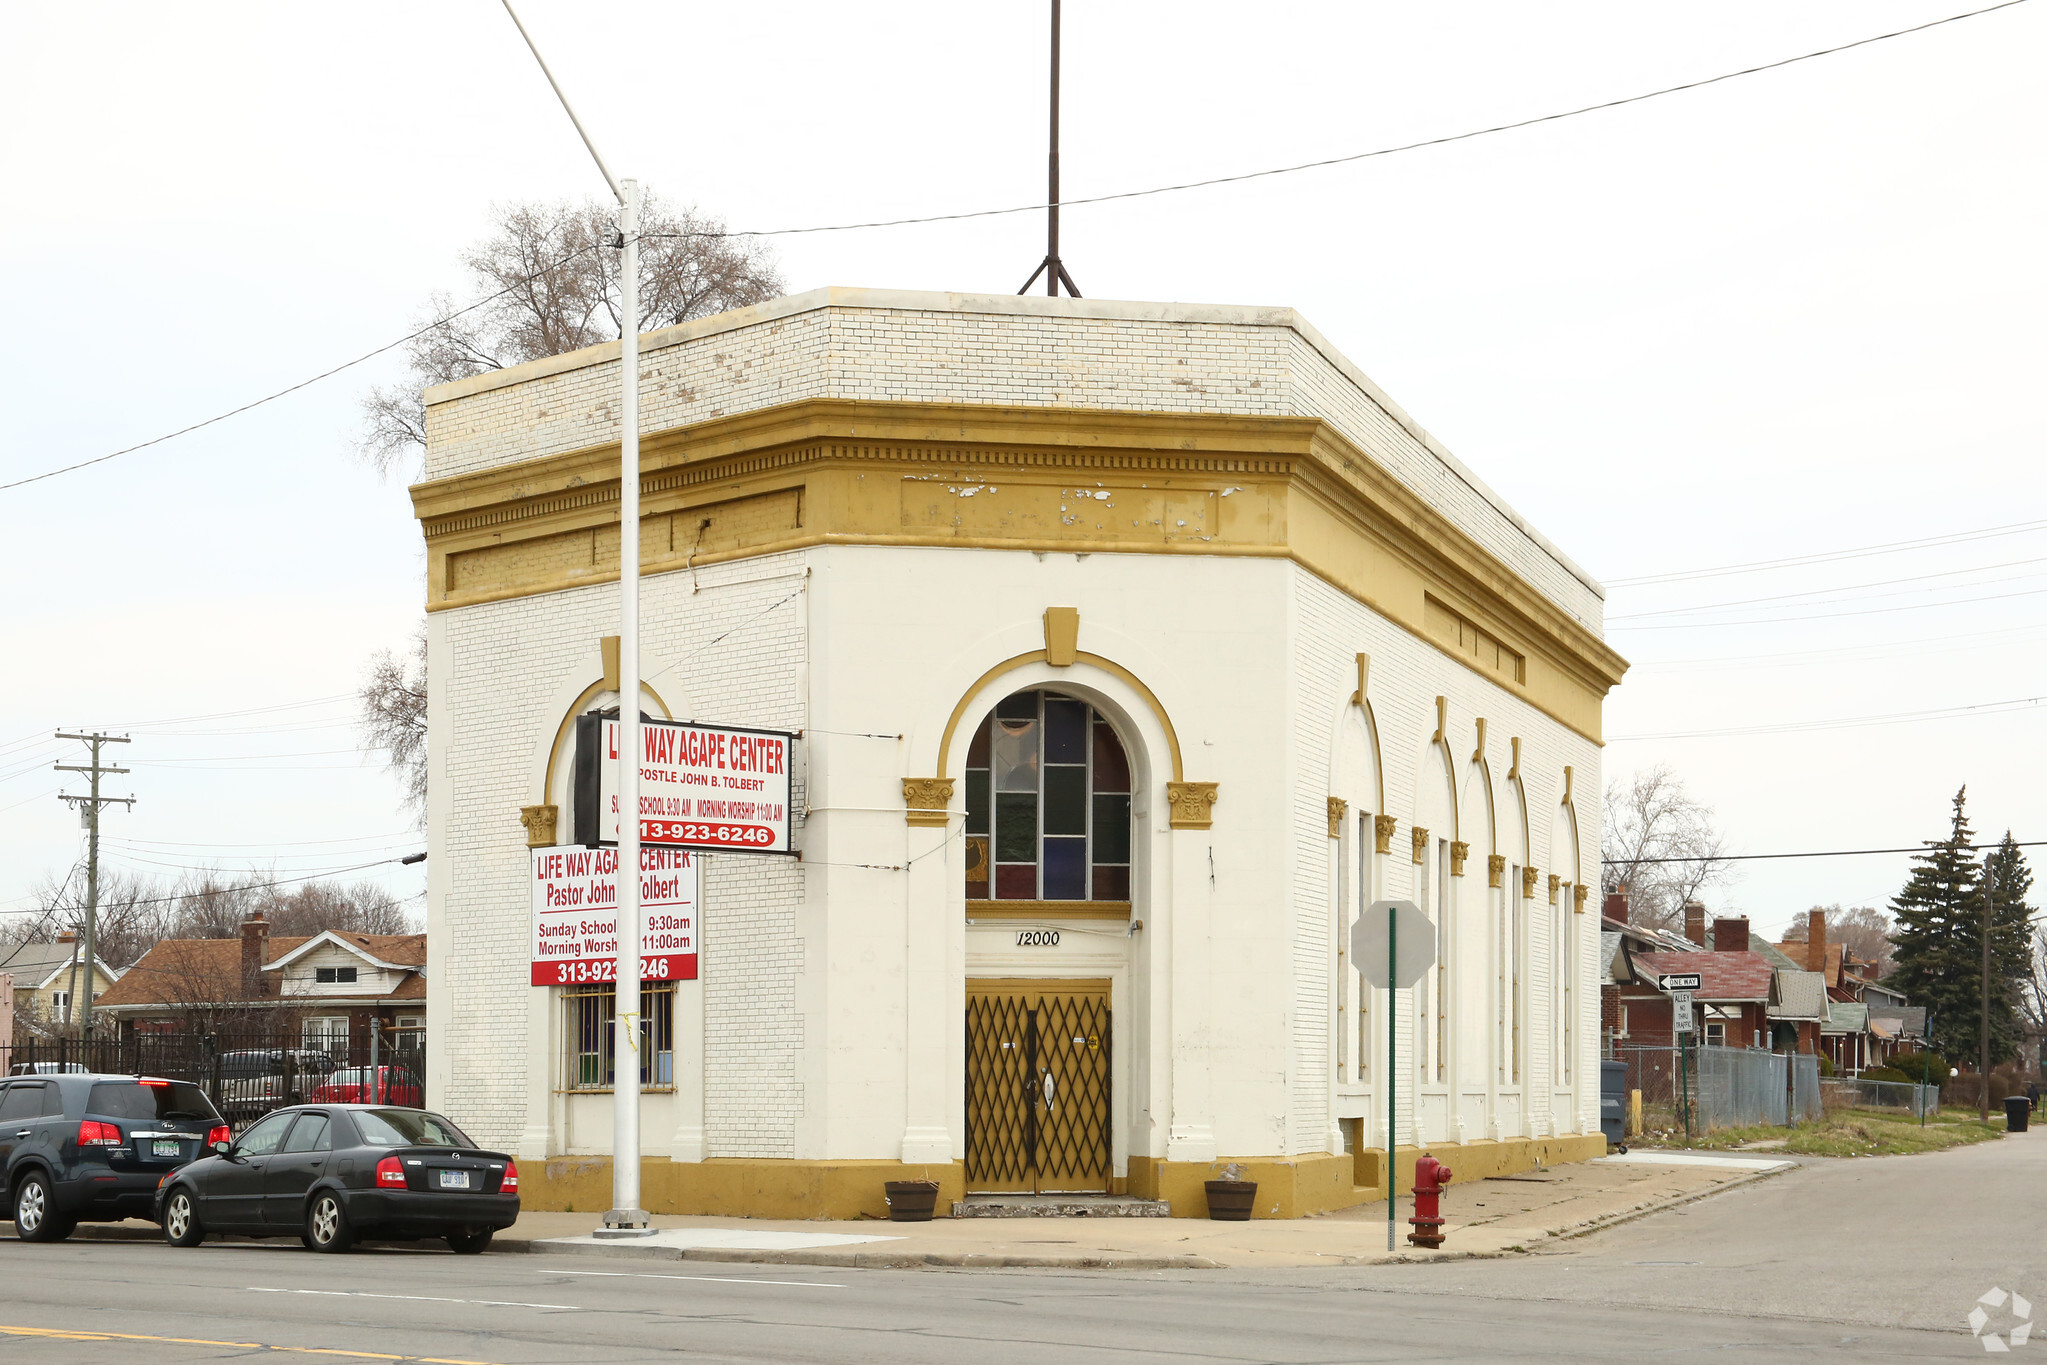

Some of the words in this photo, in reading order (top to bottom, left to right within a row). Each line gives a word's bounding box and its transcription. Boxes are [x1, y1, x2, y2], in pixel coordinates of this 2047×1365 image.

[644, 726, 676, 765] WAY
[678, 730, 725, 769] AGAPE
[729, 735, 784, 775] CENTER
[640, 768, 677, 783] POSTLE
[680, 772, 708, 786] JOHN
[711, 776, 721, 788] B.
[723, 776, 765, 792] TOLBERT
[640, 796, 666, 816] SCHOOL
[667, 797, 681, 817] 9:30
[681, 798, 692, 817] AM
[697, 799, 726, 819] MORNING
[727, 801, 756, 821] WORSHIP
[773, 803, 783, 822] AM
[640, 822, 769, 843] 13-923-6246
[537, 854, 563, 880] LIFE
[566, 852, 592, 878] WAY
[595, 849, 618, 875] AGA
[640, 848, 691, 872] CENTER
[547, 882, 584, 907] Pastor
[587, 878, 615, 904] John
[640, 874, 679, 900] olbert
[539, 922, 577, 939] Sunday
[580, 918, 617, 935] School
[648, 915, 690, 931] 9:30am
[1017, 931, 1060, 946] 12000
[539, 940, 581, 957] Morning
[584, 937, 617, 953] Worsh
[642, 934, 690, 950] 11:00am
[1675, 995, 1689, 1003] ALLEY
[1676, 1021, 1691, 1029] TRAFFIC
